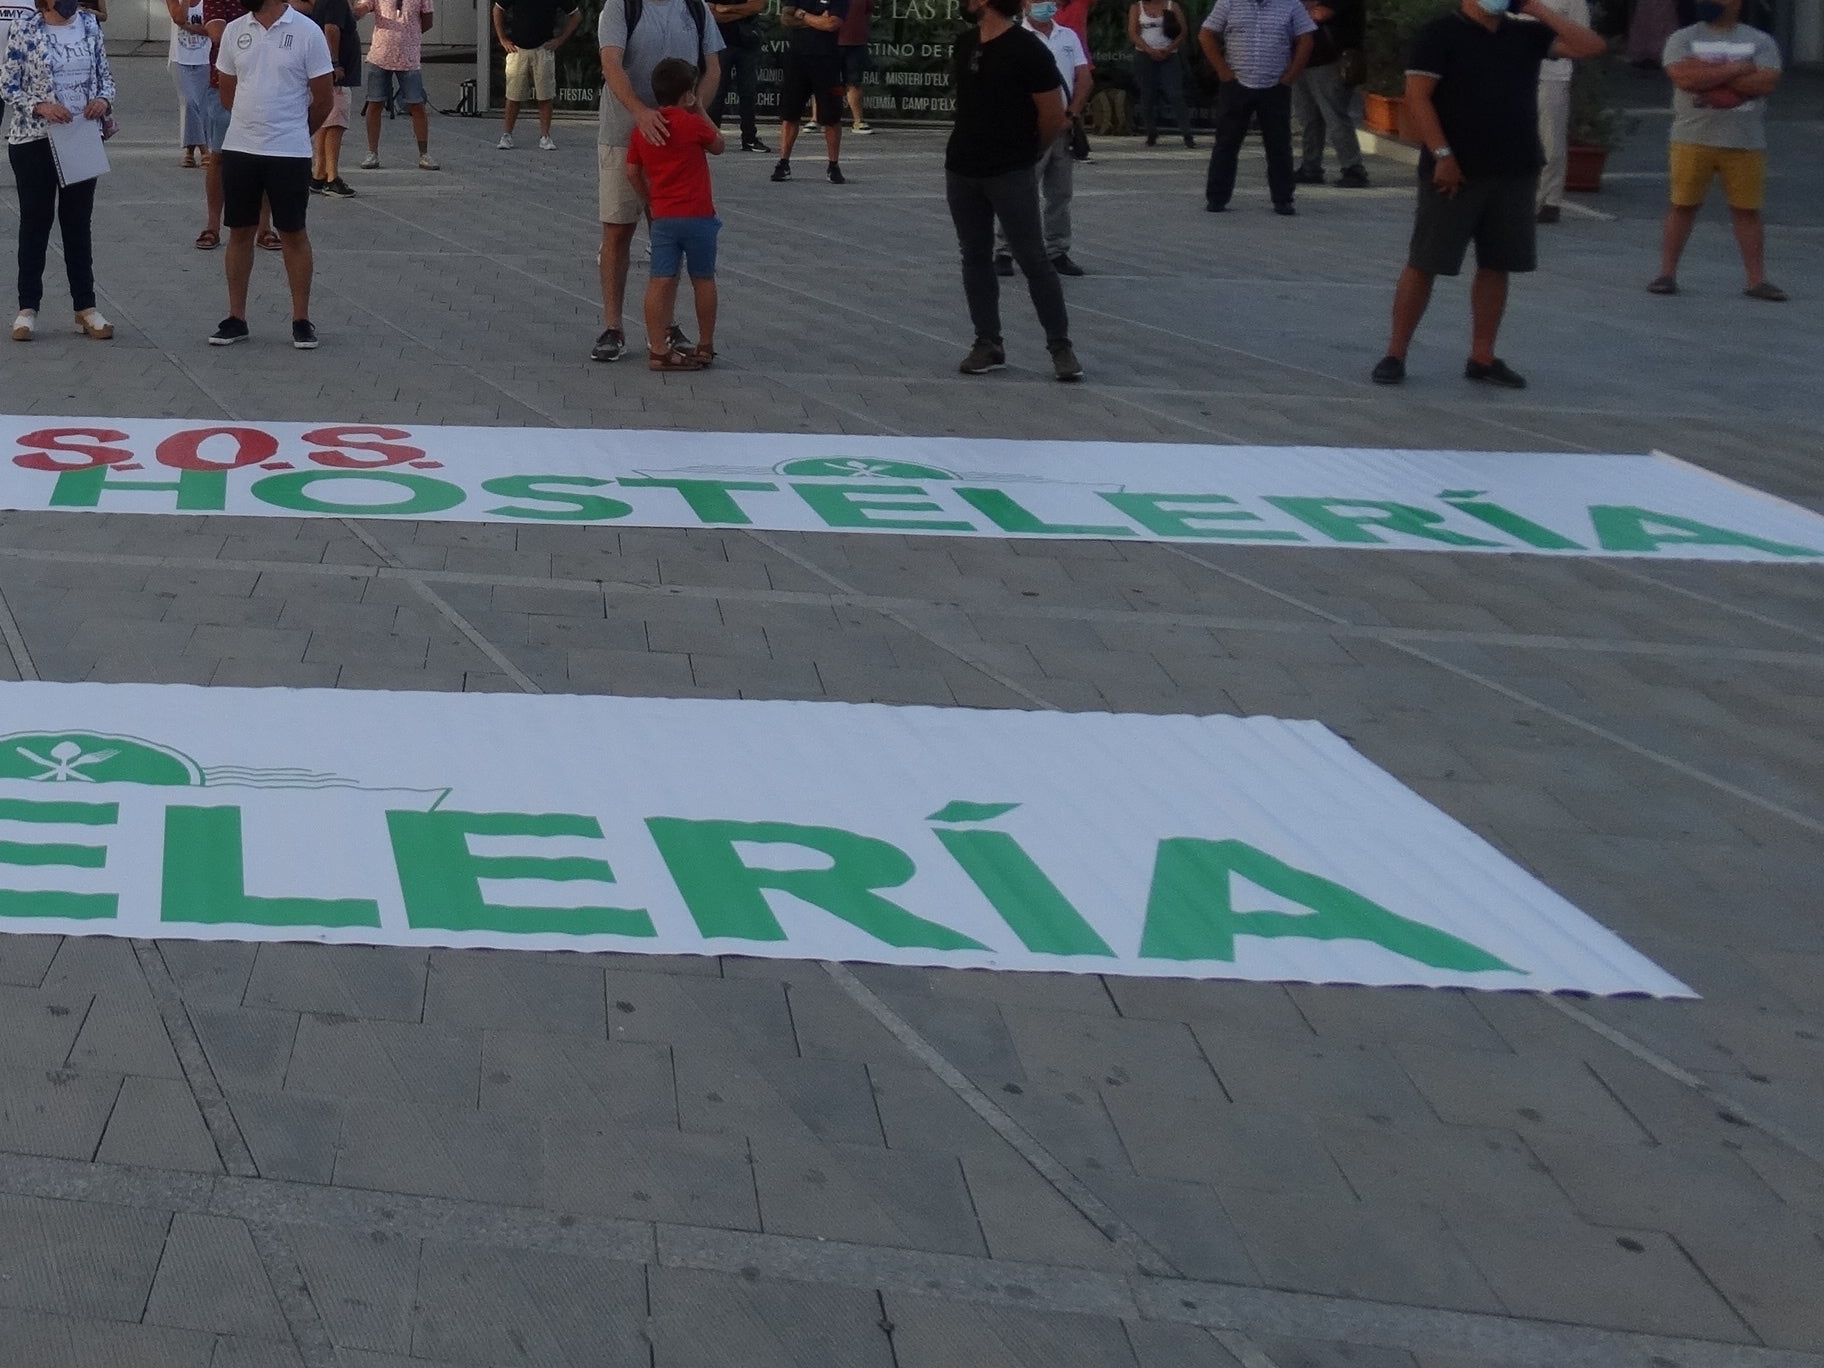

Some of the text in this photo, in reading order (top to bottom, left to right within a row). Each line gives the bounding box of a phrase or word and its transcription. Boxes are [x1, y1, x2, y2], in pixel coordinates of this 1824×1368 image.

[885, 72, 924, 86] MISTERI
[924, 73, 950, 87] D'ELX
[559, 87, 594, 102] FIESTAS
[901, 96, 930, 111] CAMP
[48, 465, 1824, 557] HOSTELERÍA
